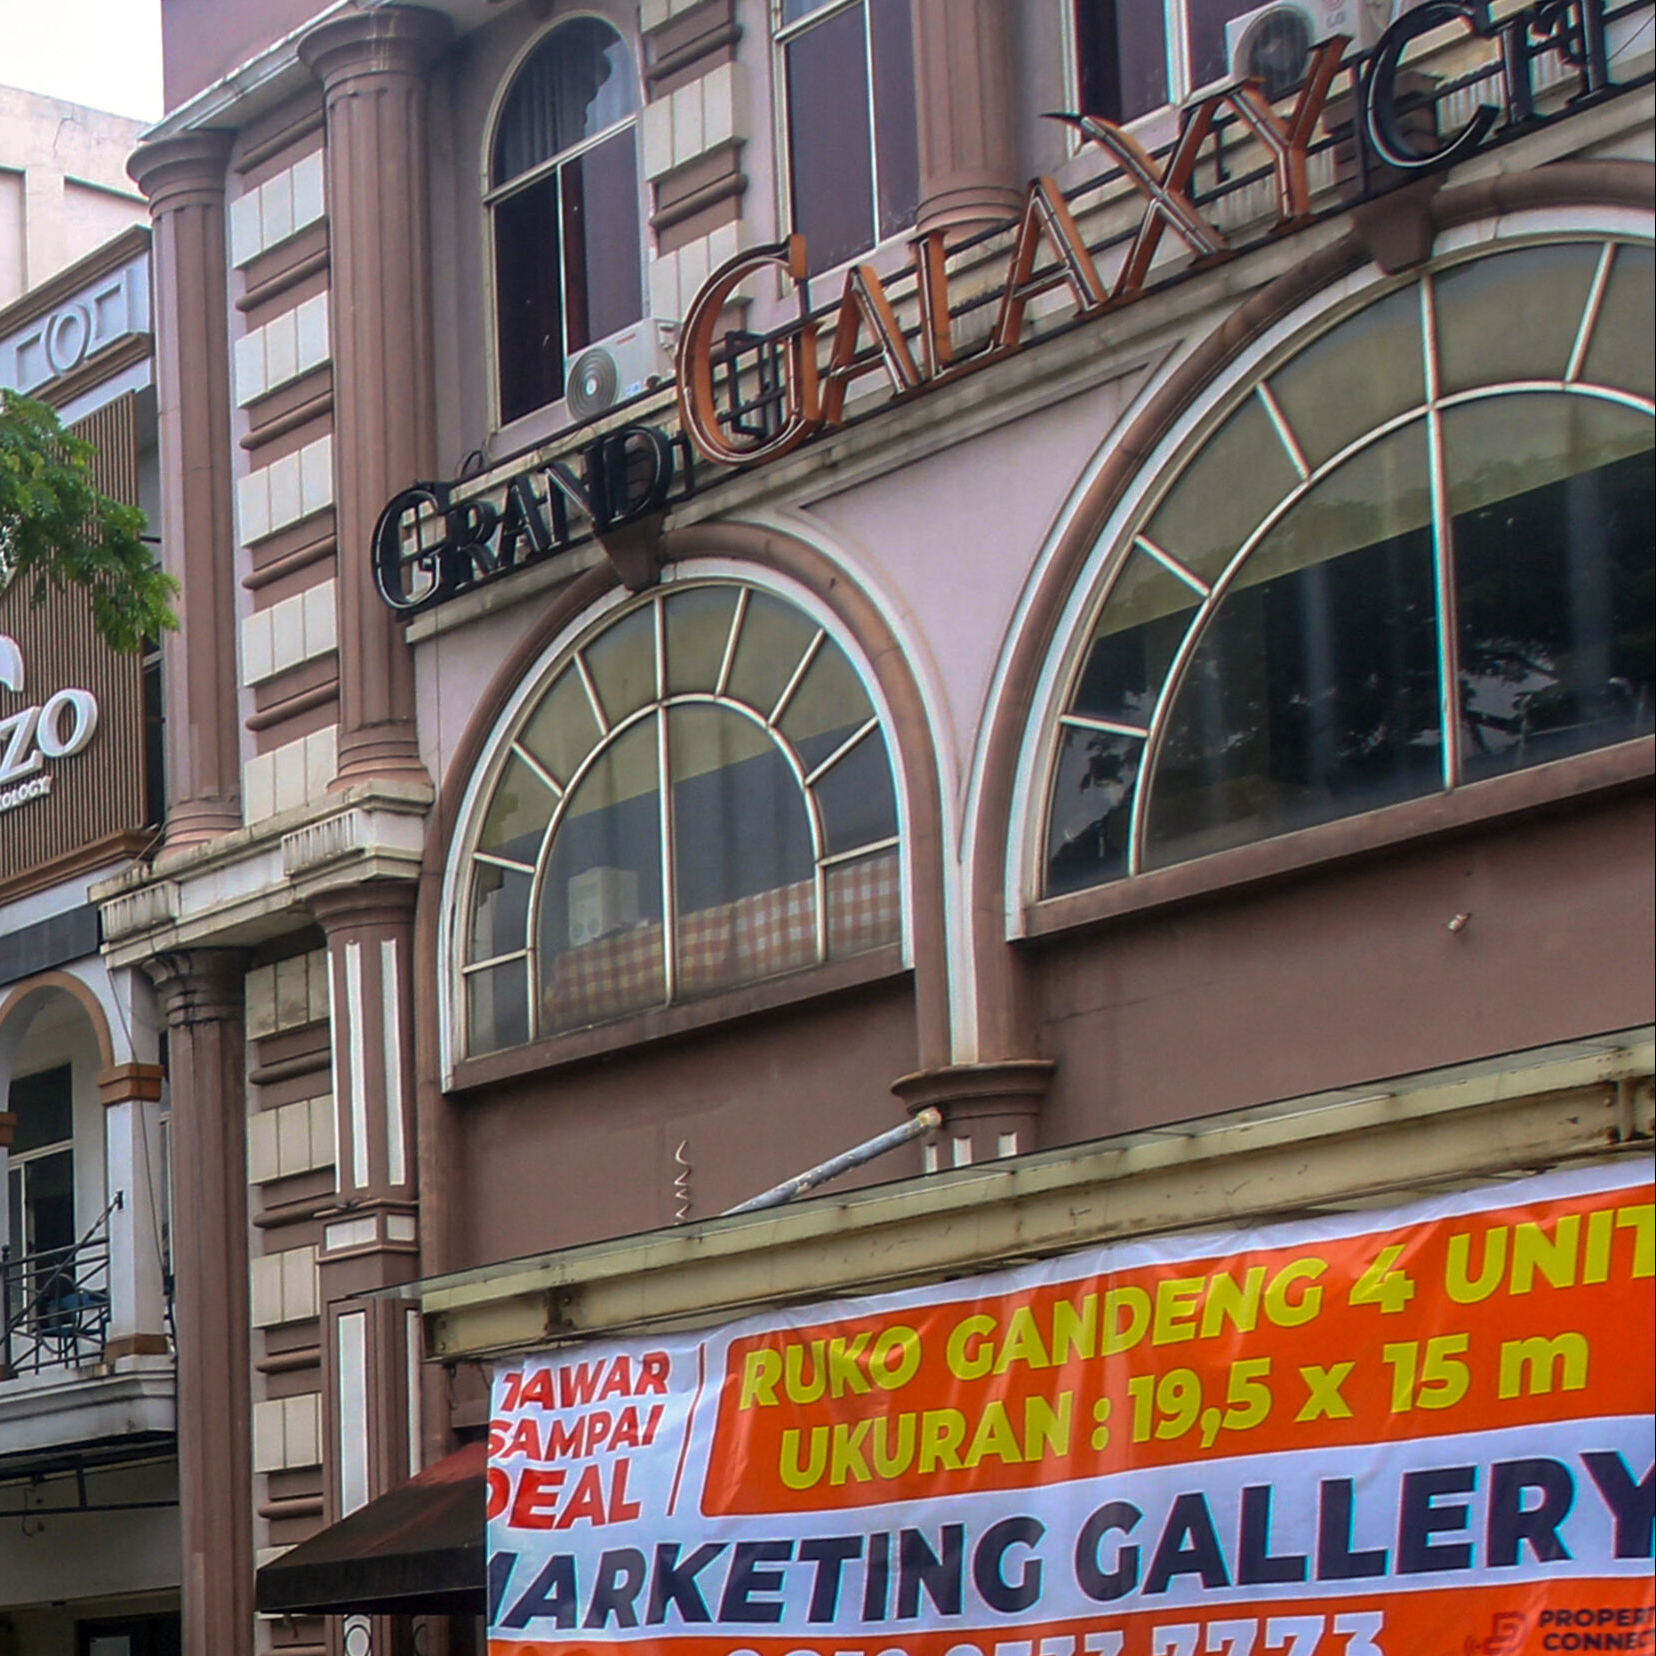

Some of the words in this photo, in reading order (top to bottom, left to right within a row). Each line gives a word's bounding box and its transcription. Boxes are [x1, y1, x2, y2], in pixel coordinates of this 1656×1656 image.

[371, 424, 674, 612] GRAND
[676, 34, 1354, 467] GALAXY
[740, 1326, 922, 1411] RUKO
[947, 1257, 1329, 1381] GANDENG
[1348, 1244, 1415, 1314] 4
[1444, 1203, 1655, 1305] UNIT
[487, 1405, 665, 1462] SAMPAI
[779, 1391, 1073, 1490] UKURAN
[1128, 1357, 1272, 1449] 19,5
[1293, 1361, 1357, 1423] x
[1382, 1332, 1471, 1414] 15
[1497, 1332, 1589, 1401] m
[1075, 1450, 1655, 1603] GALLERY
